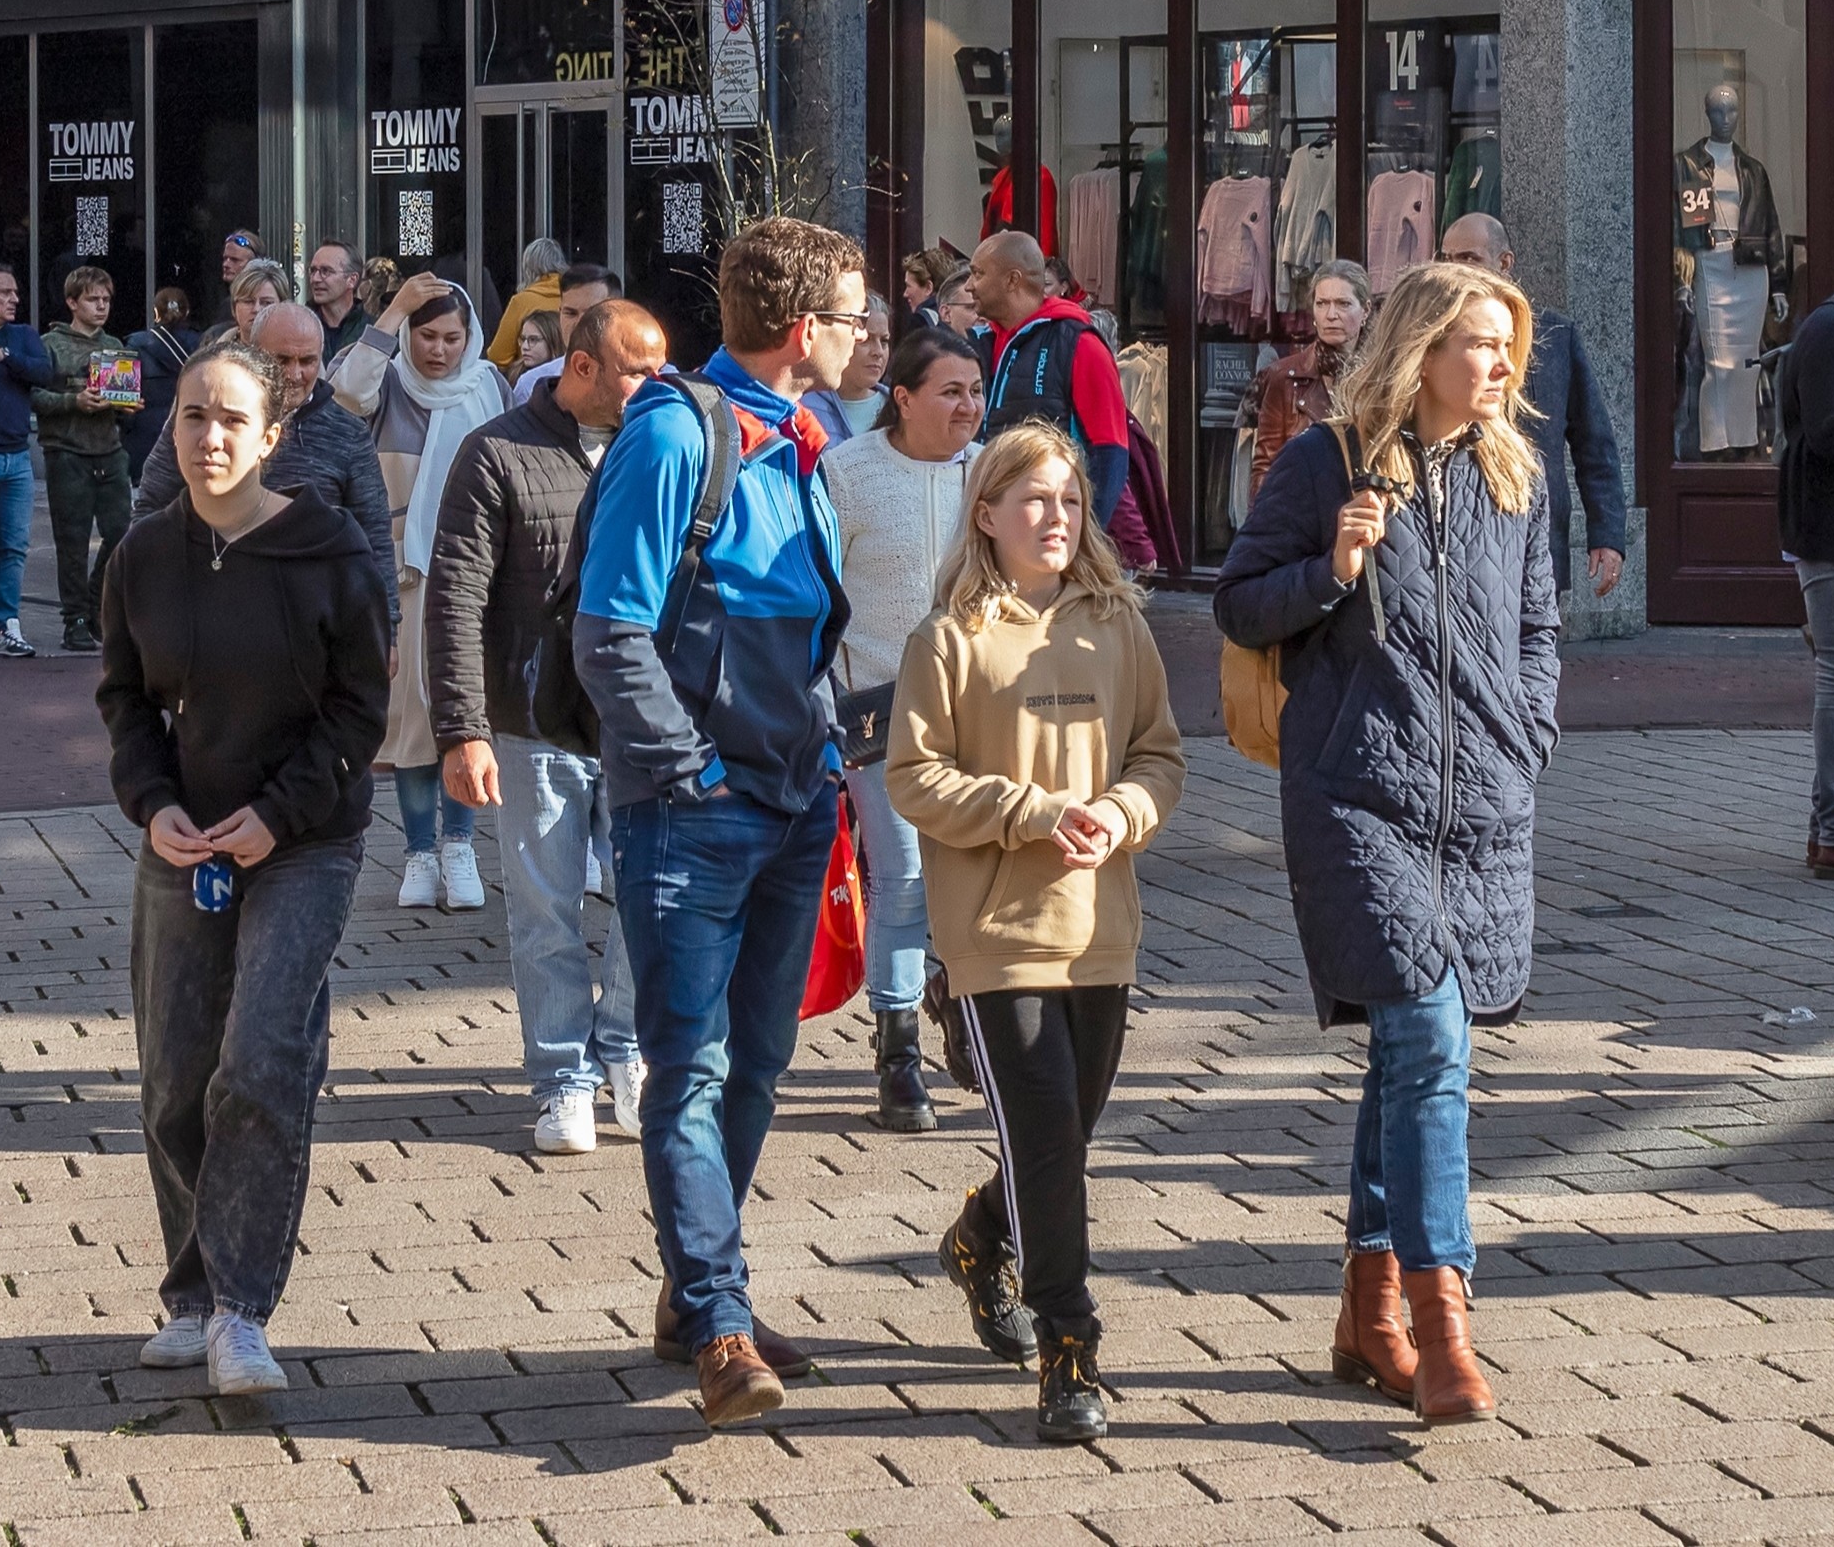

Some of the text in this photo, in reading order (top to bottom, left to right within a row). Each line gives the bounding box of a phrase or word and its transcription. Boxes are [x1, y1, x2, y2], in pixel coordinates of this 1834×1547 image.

[1385, 30, 1419, 91] 14
[371, 107, 461, 146] TOMMY
[630, 94, 716, 135] TOMM
[49, 121, 135, 156] TOMMY
[83, 157, 134, 181] JEANS
[407, 146, 460, 172] JEANS
[1682, 188, 1710, 213] 34
